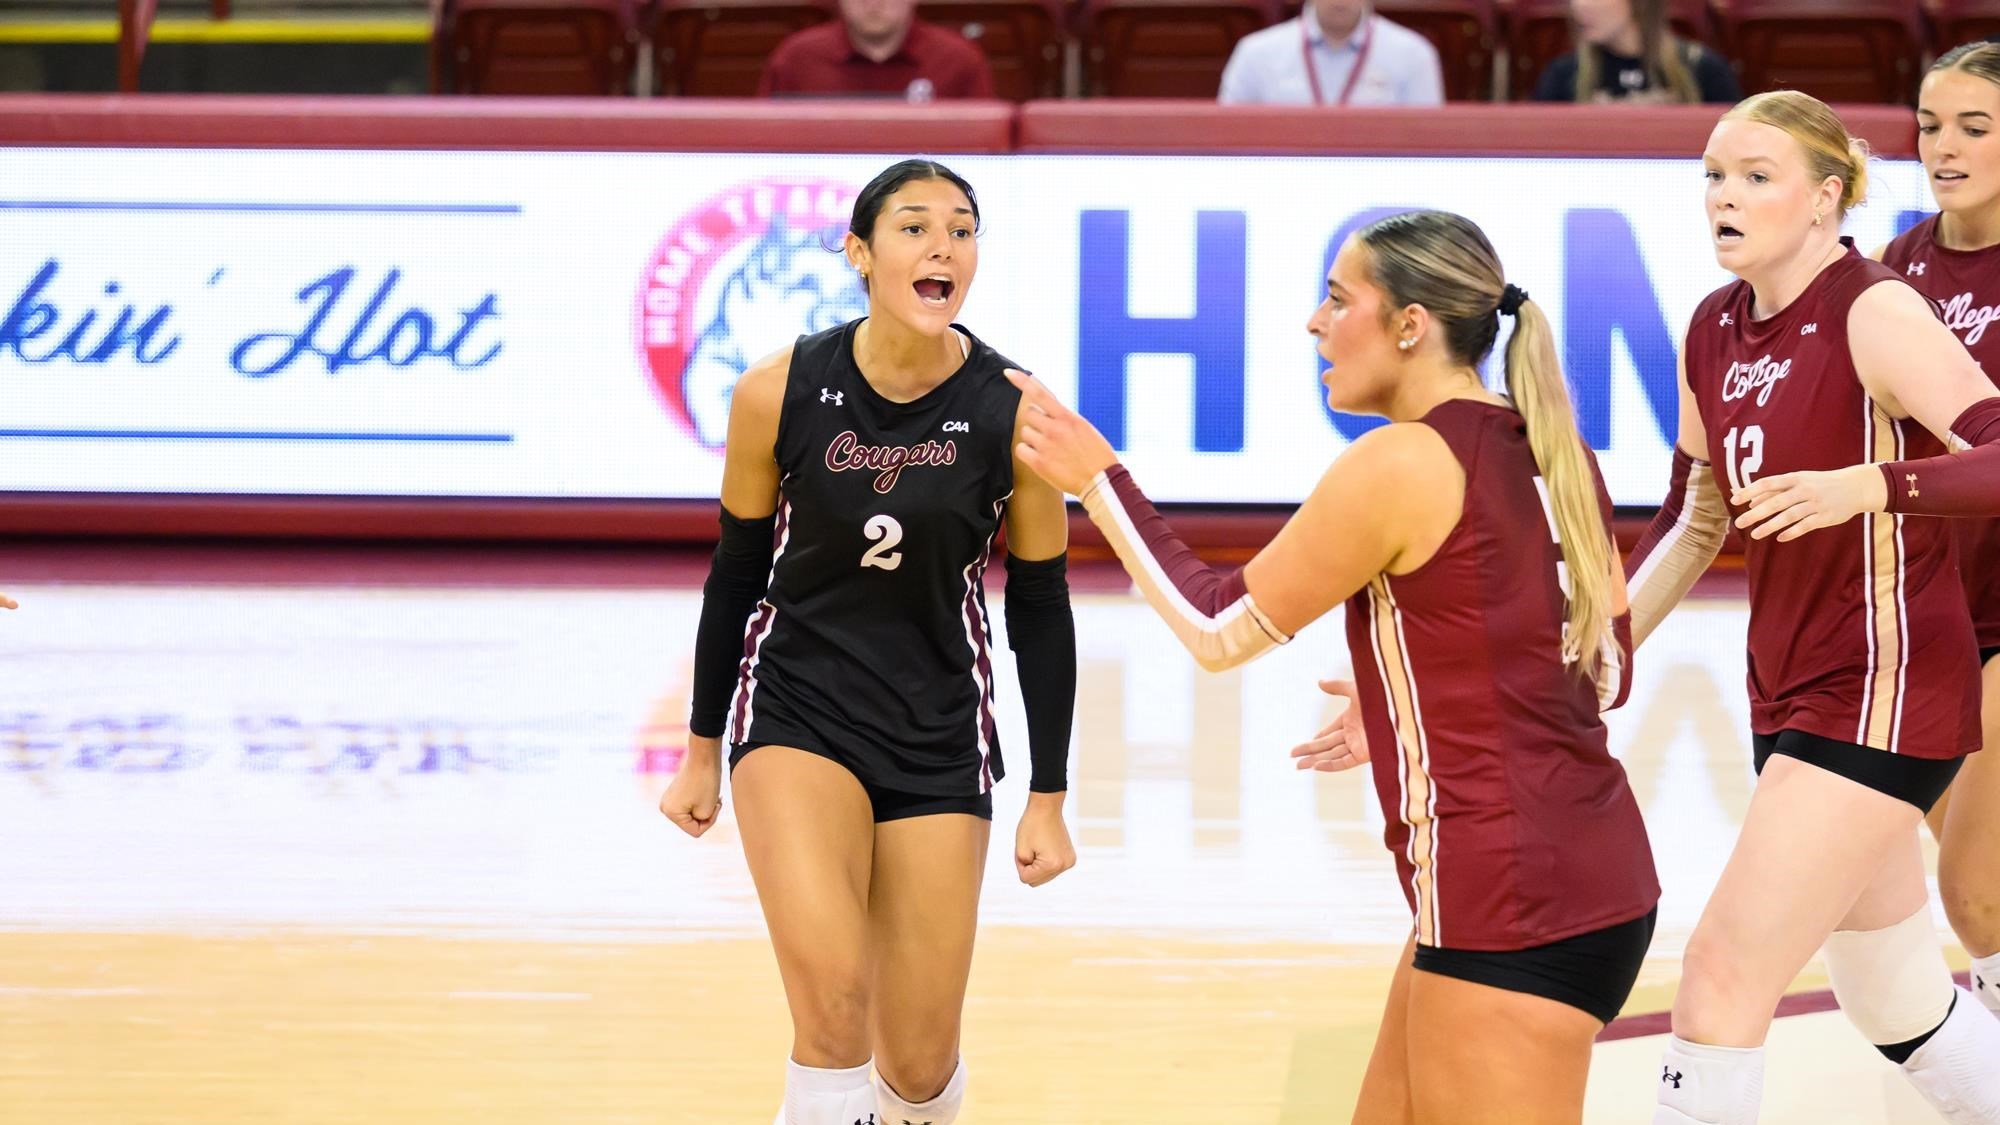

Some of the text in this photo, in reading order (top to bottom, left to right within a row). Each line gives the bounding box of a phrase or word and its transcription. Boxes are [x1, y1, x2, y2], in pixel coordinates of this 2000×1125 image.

[645, 228, 716, 346] HOME
[228, 264, 502, 378] Hot
[1800, 322, 1817, 336] CAA
[942, 421, 970, 433] CAA
[1722, 424, 1765, 494] 12
[825, 430, 957, 494] Cougars
[860, 514, 903, 571] 2
